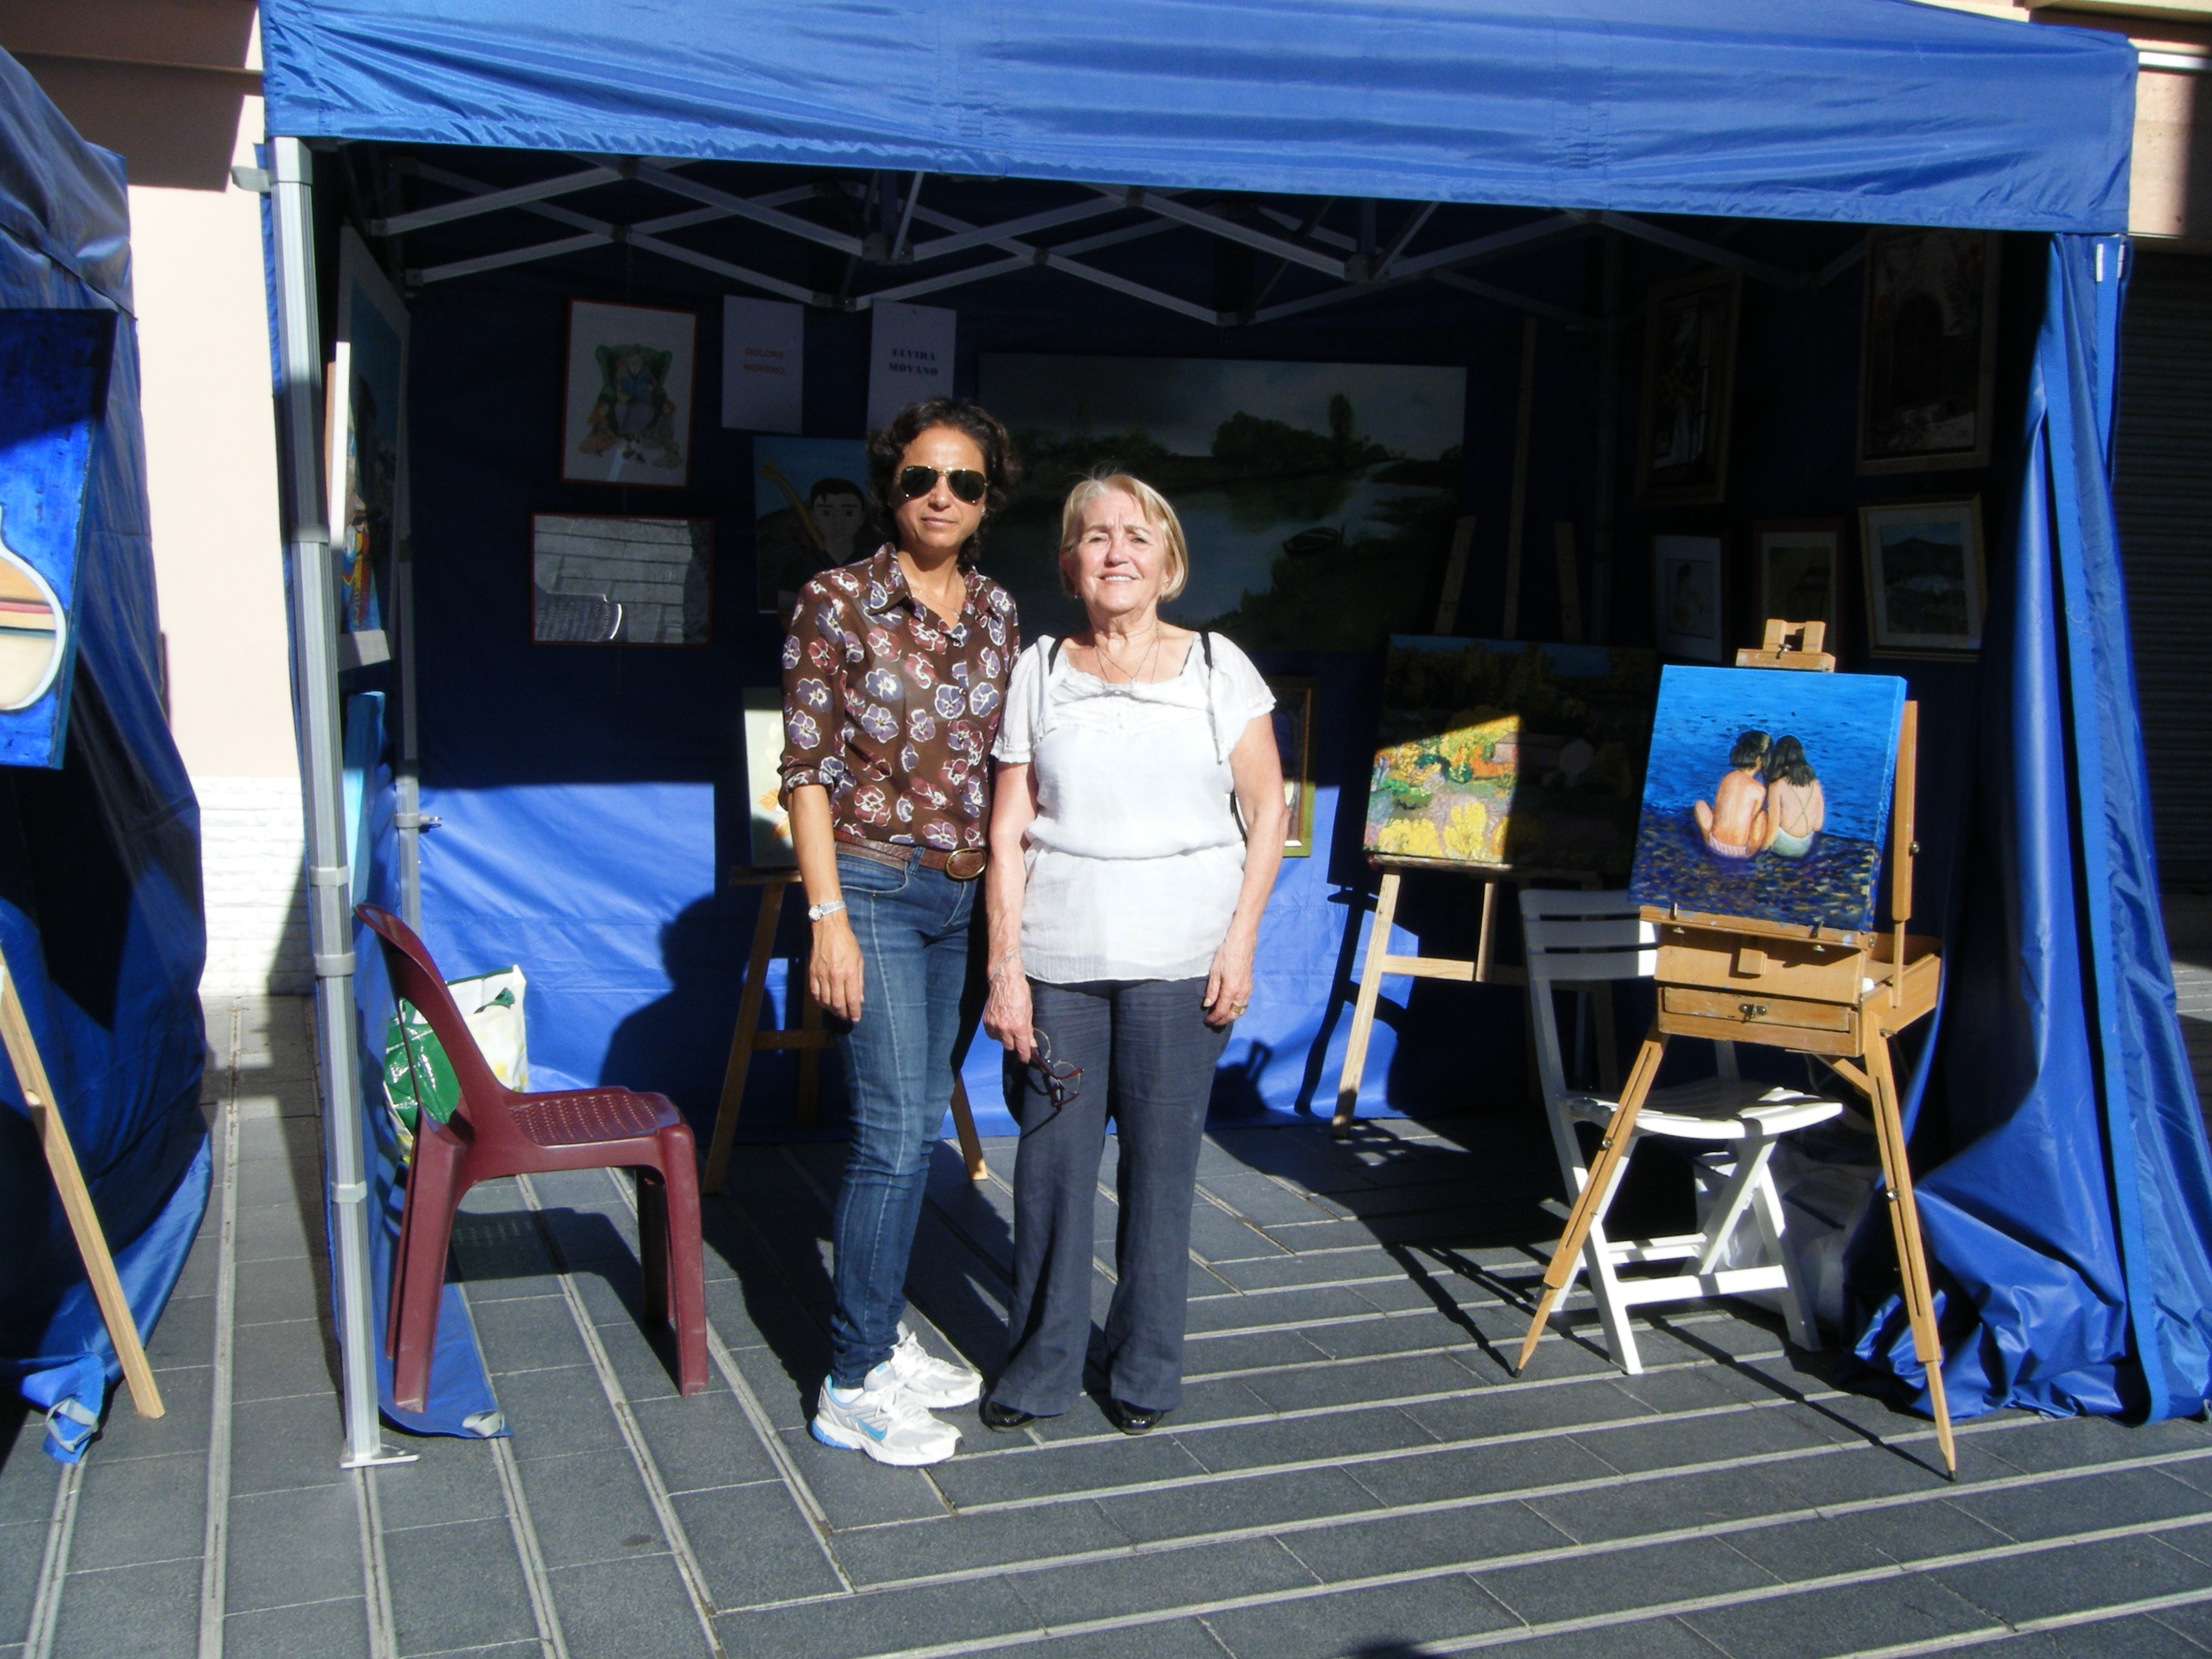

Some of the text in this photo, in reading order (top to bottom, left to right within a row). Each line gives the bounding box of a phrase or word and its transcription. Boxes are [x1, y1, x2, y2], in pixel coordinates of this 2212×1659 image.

[745, 347, 783, 359] DOLORS
[893, 348, 935, 361] ELVIRA
[743, 363, 785, 374] MORENO
